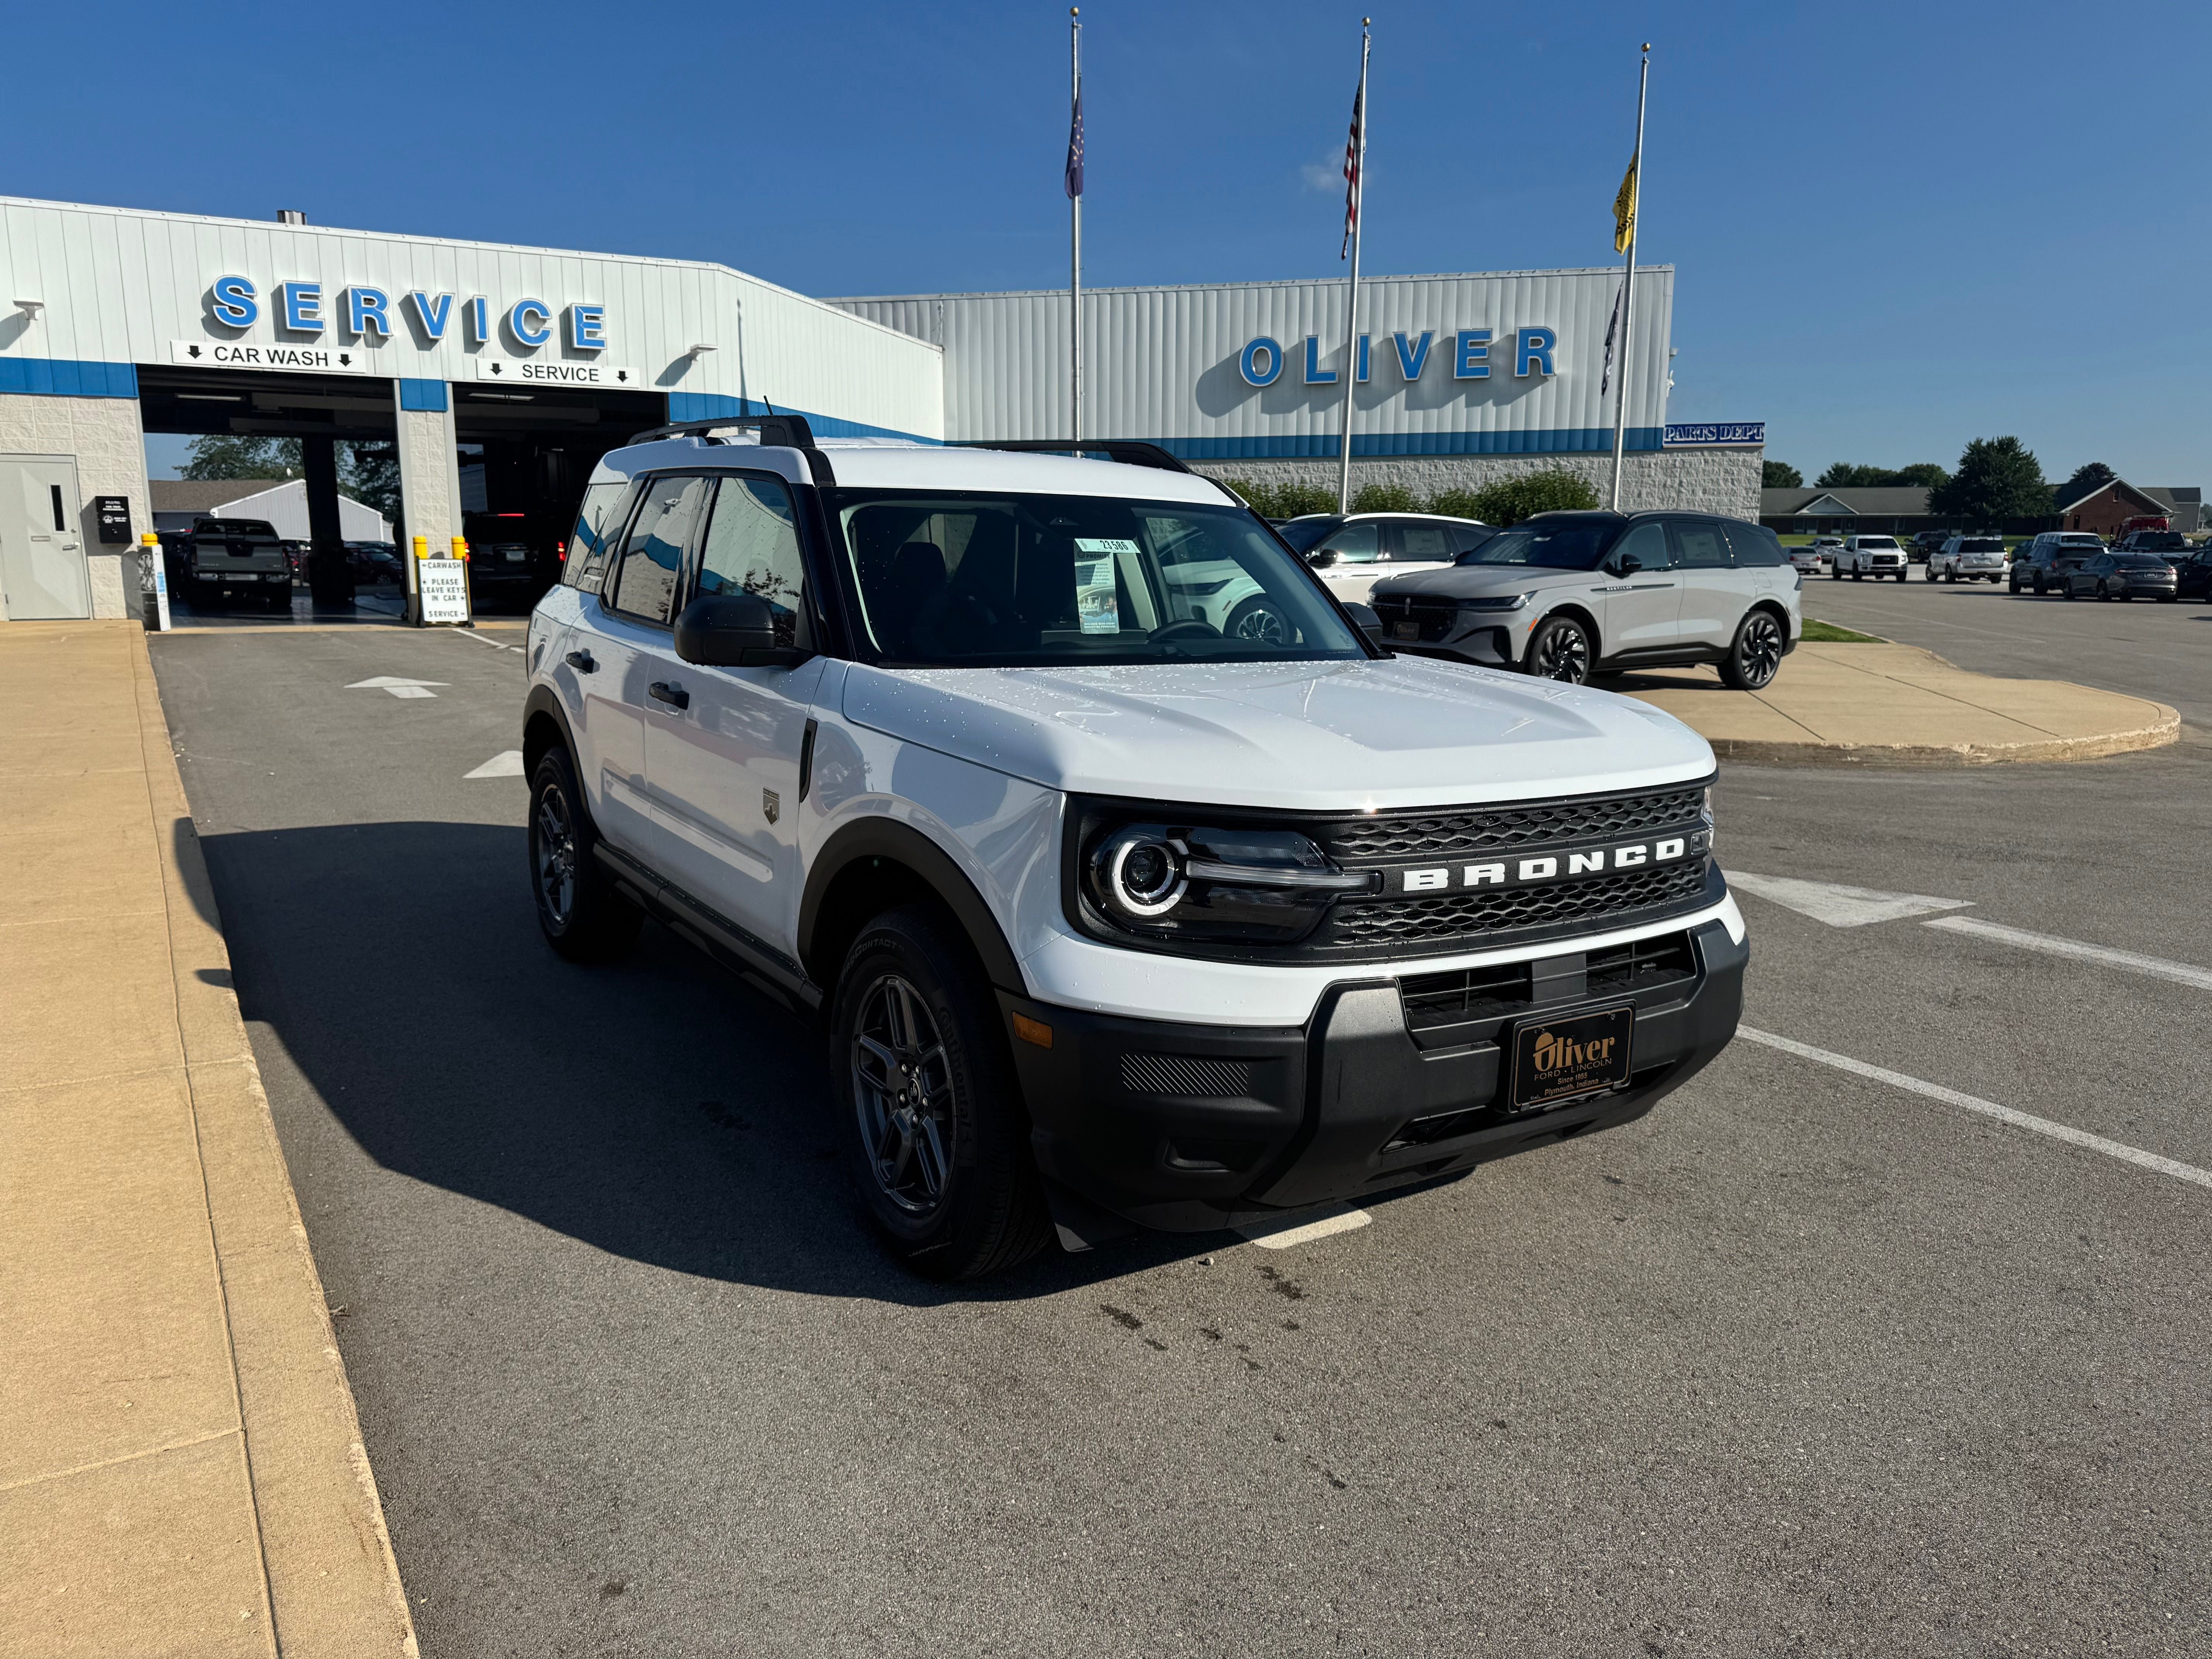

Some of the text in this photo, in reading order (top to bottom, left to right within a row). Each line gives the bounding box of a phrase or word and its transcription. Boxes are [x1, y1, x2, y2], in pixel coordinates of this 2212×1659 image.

[213, 275, 606, 350] SERVICE
[215, 347, 328, 366] CAR WASH
[1239, 326, 1556, 386] OLIVER
[522, 364, 599, 382] SERVICE
[1664, 425, 1764, 441] PARTS DEPT
[1100, 540, 1128, 550] 23586
[1402, 838, 1684, 891] BRONCO
[1533, 1032, 1615, 1072] Oliver
[1534, 1058, 1612, 1081] FORD LINCOLN
[1558, 1072, 1588, 1085] Since 1955
[1577, 1078, 1599, 1088] Indiana
